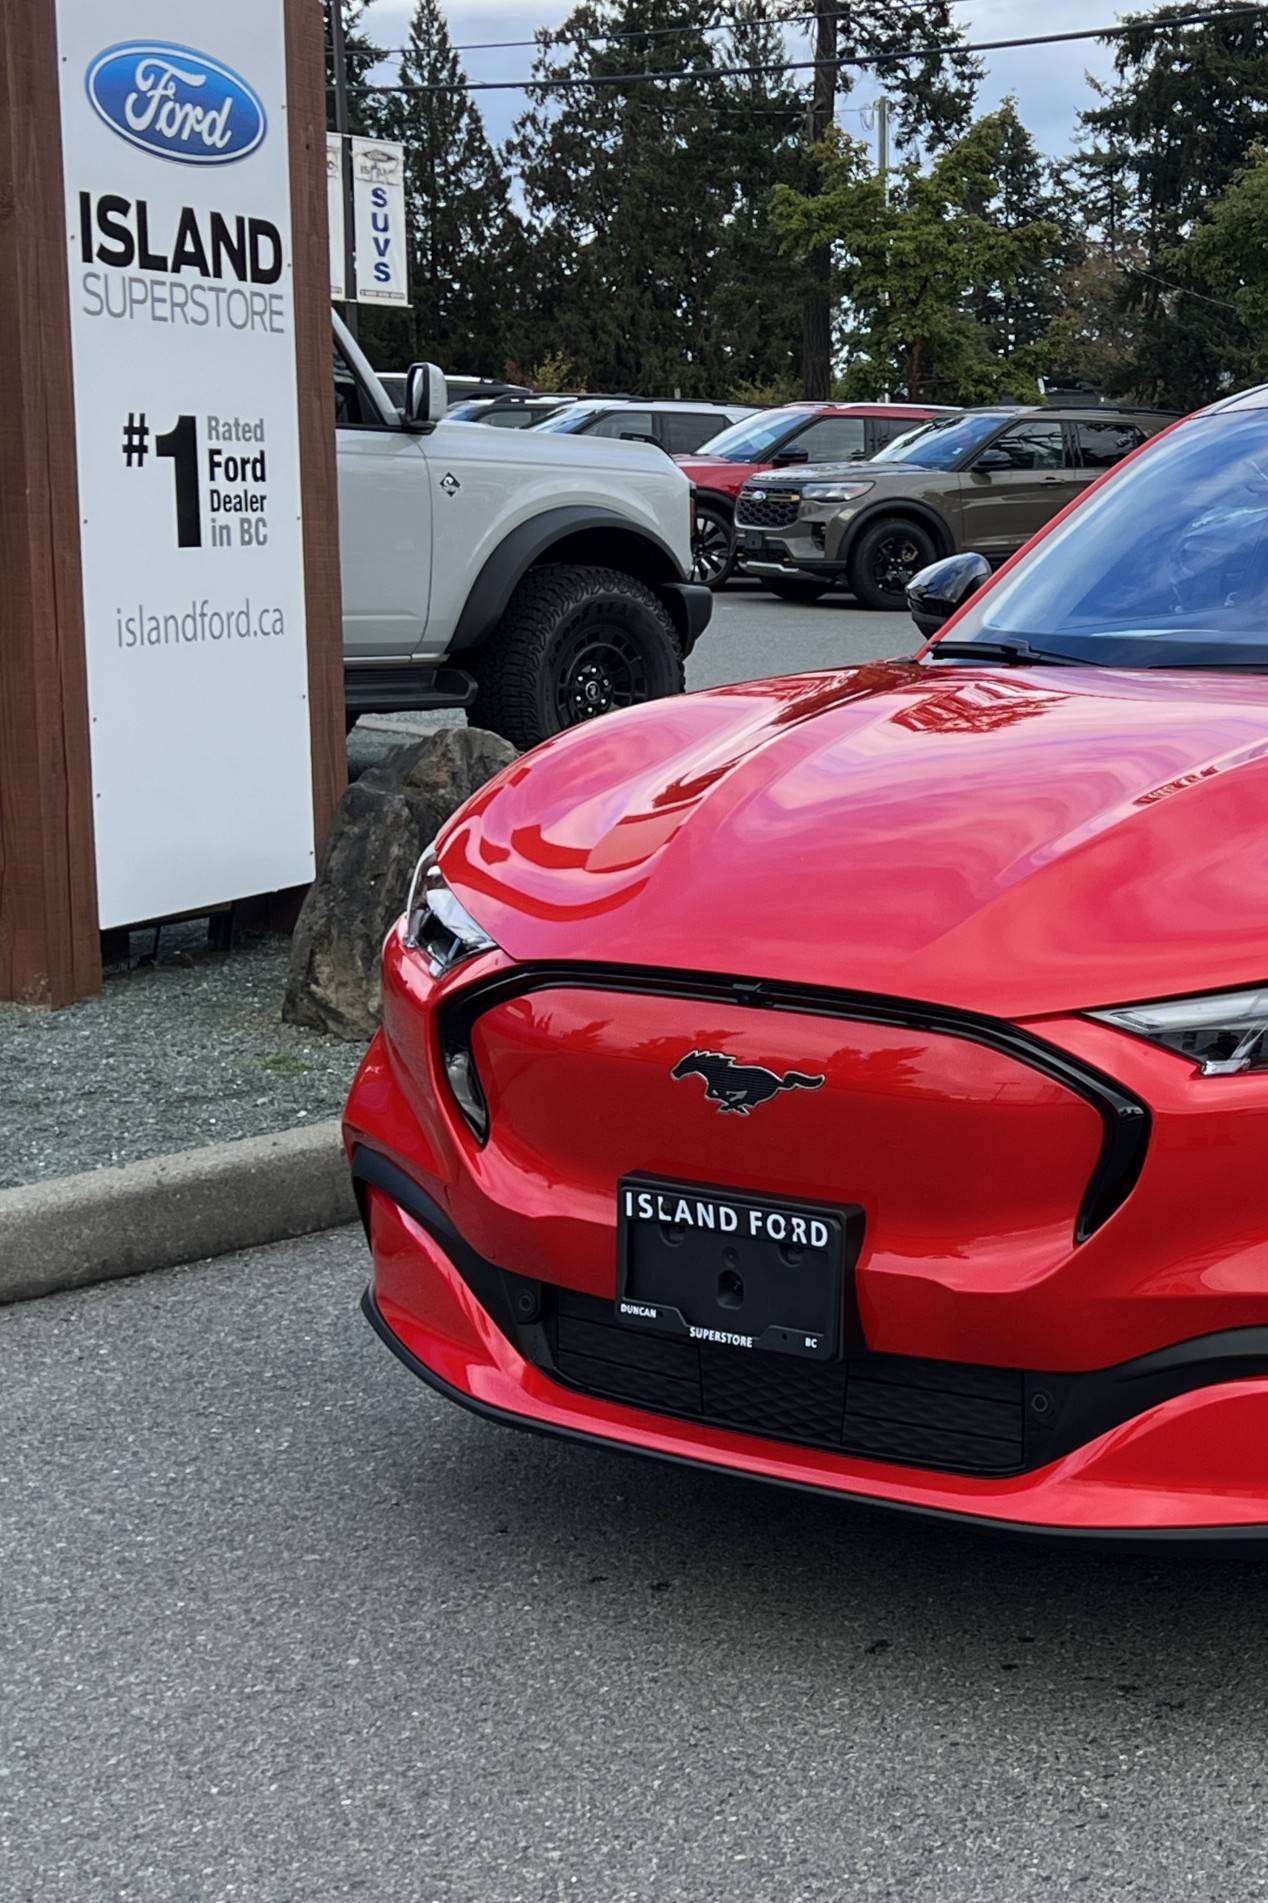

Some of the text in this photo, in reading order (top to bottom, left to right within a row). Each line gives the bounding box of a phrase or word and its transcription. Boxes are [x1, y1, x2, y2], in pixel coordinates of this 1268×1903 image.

[124, 57, 233, 149] Ford
[79, 191, 283, 285] ISLAND
[371, 186, 392, 283] SUVS
[82, 272, 284, 334] SUPERSTORE
[207, 415, 265, 443] Rated
[122, 412, 202, 548] #1
[208, 448, 267, 483] Ford
[209, 489, 268, 513] Dealer
[211, 517, 268, 548] in BC
[115, 598, 285, 648] islandford.ca
[625, 1191, 829, 1248] ISLAND FORD
[620, 1303, 657, 1319] DUNCAN
[689, 1326, 753, 1349] SUPERSTORE
[804, 1337, 818, 1349] BC
